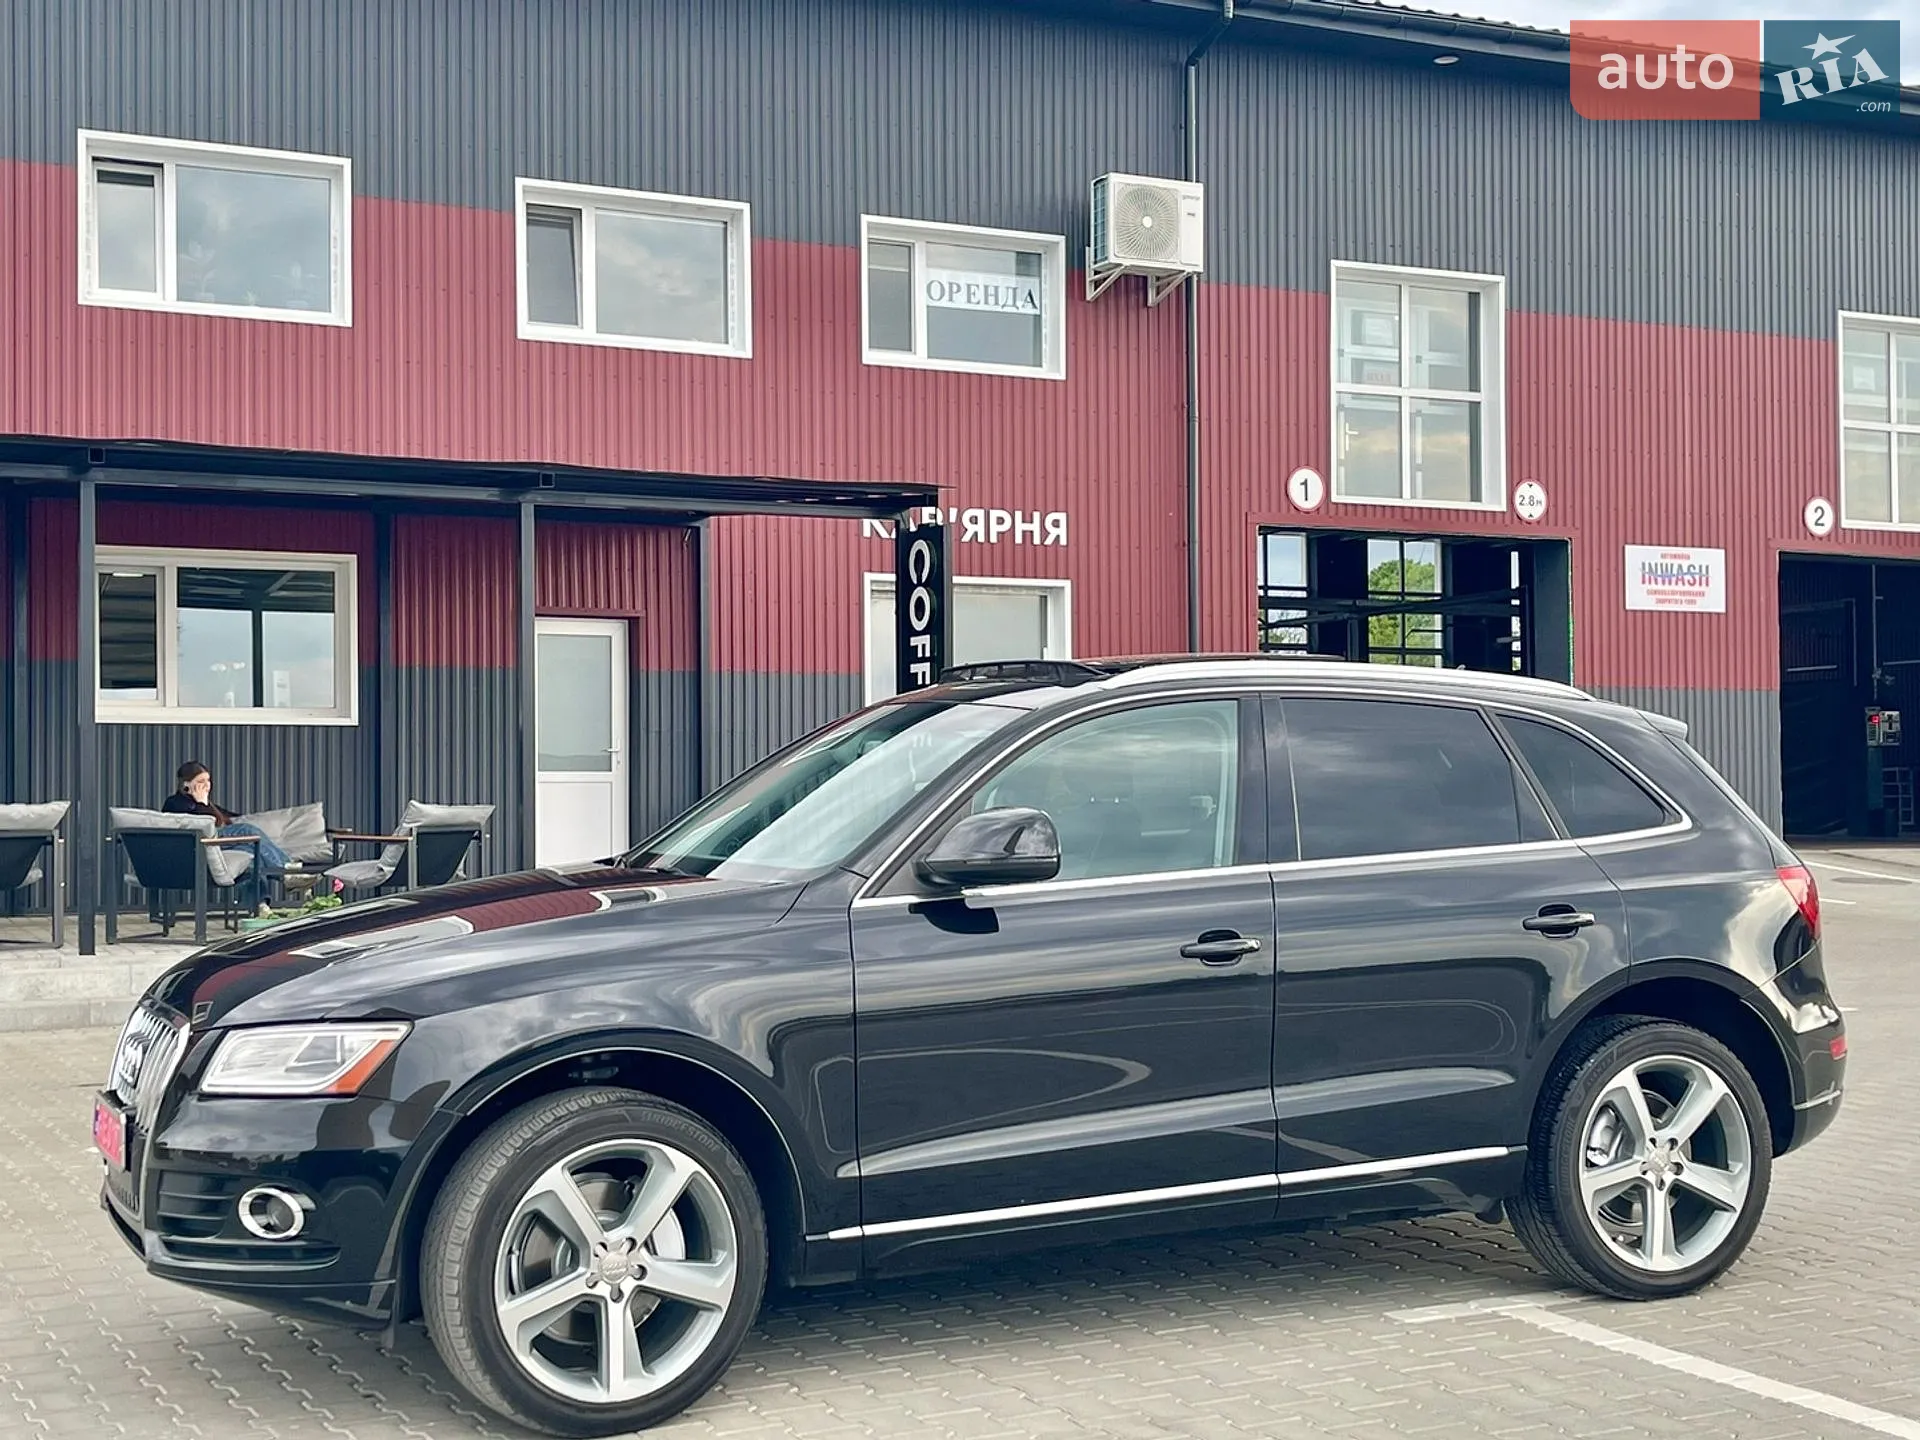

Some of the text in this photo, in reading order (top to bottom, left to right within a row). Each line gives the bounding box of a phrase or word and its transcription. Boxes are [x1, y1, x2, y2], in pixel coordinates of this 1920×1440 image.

[926, 279, 1039, 311] ОРЕНДА
[1299, 477, 1308, 501] 1
[1814, 505, 1825, 527] 2
[1640, 561, 1710, 588] INWASH
